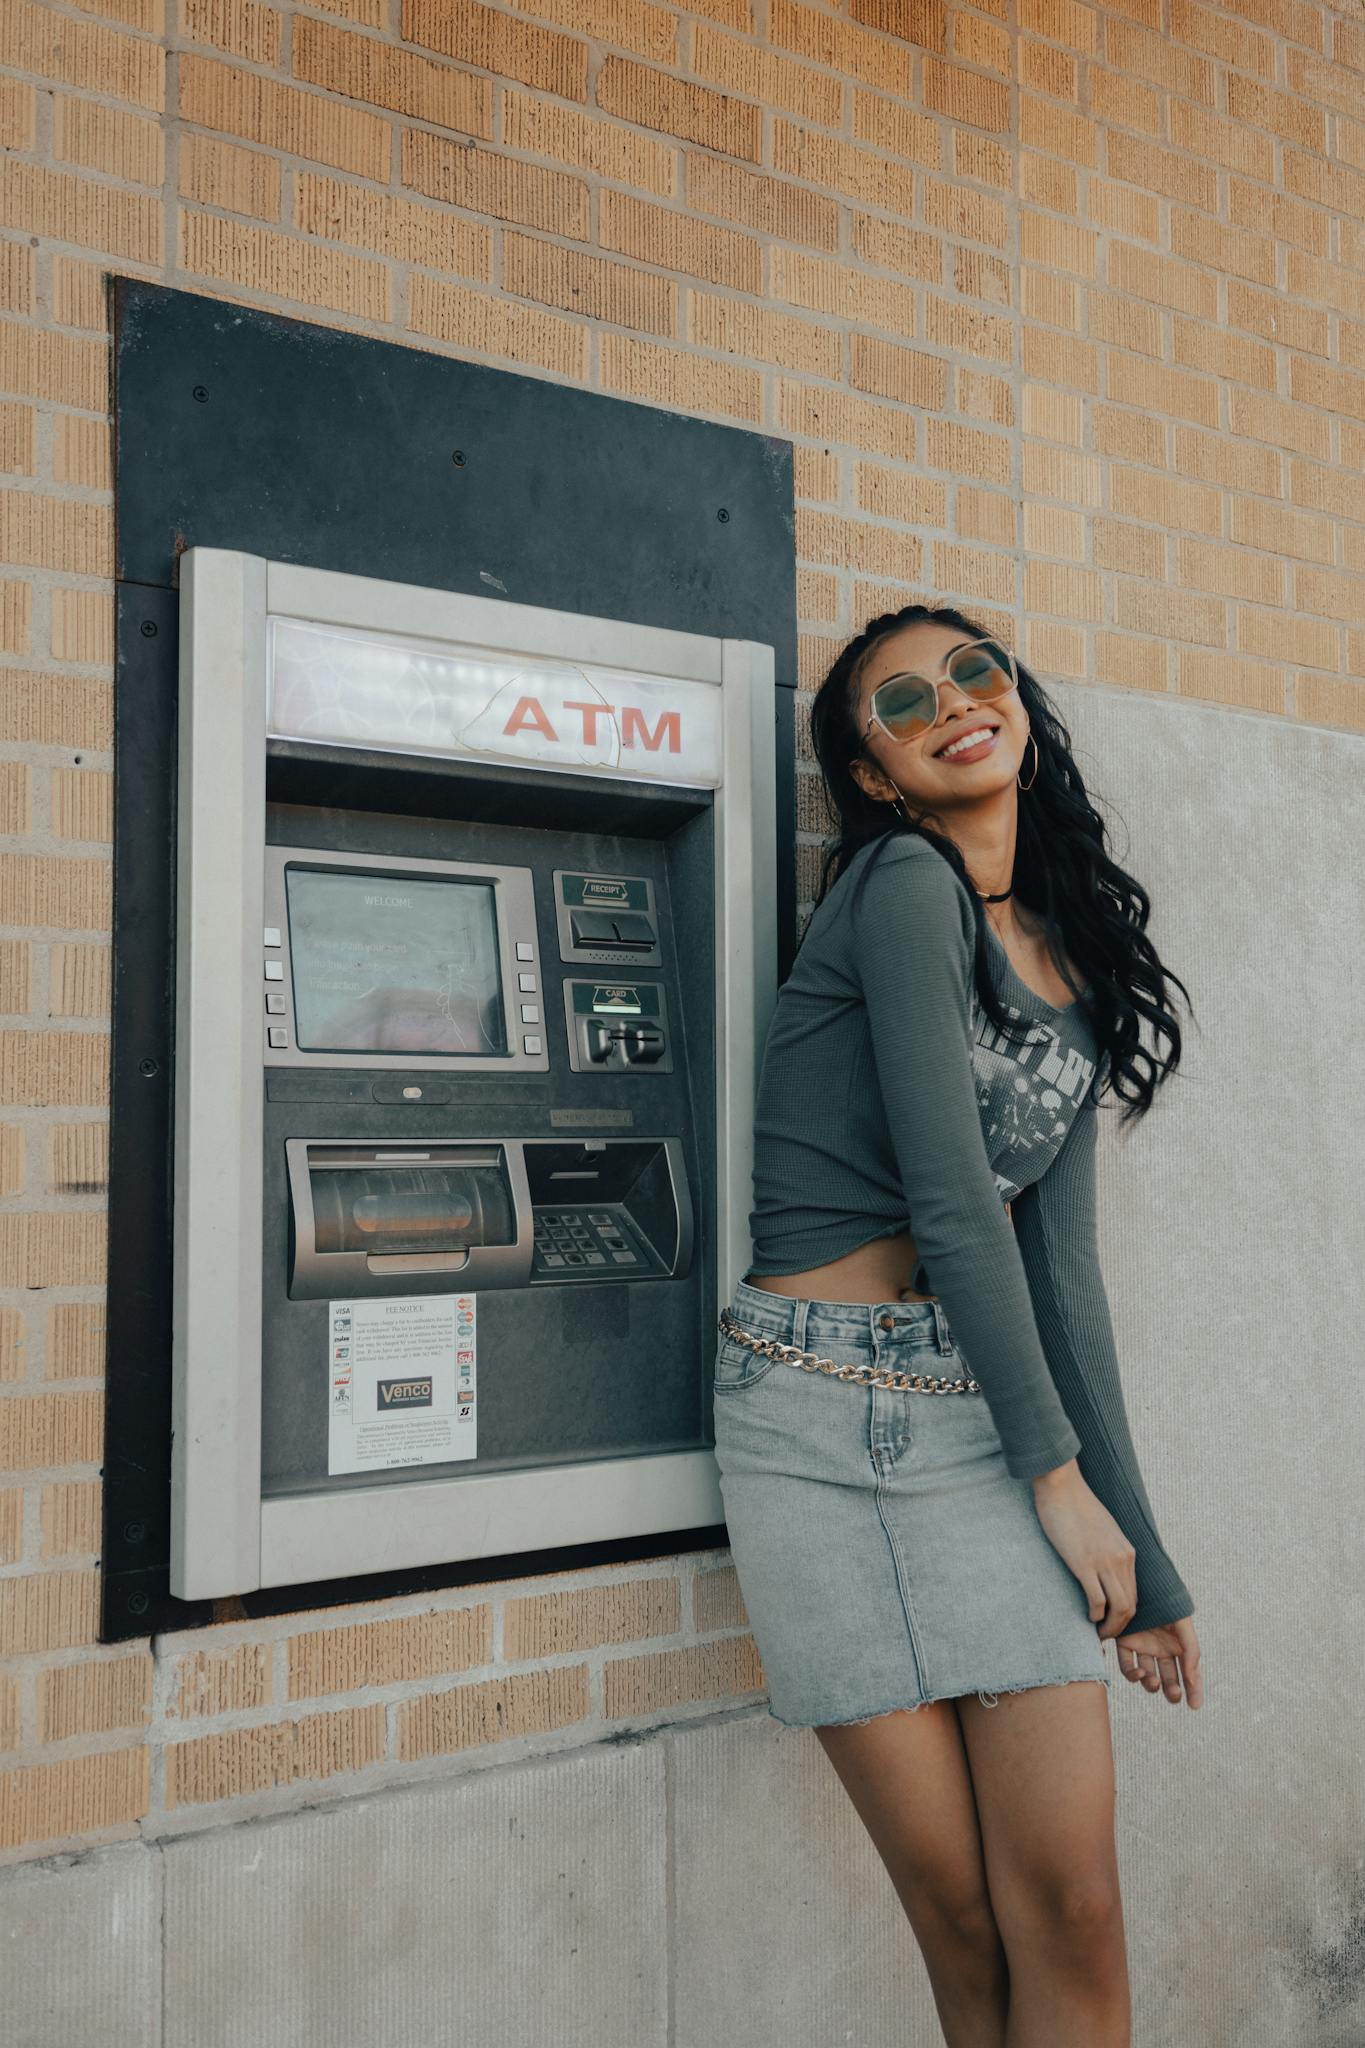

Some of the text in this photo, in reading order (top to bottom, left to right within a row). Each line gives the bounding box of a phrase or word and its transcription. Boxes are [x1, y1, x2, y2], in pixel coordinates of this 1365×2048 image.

[501, 695, 682, 754] ATM
[590, 884, 620, 895] RECEIPT
[363, 895, 414, 908] WELCOME
[605, 989, 627, 998] CARD
[335, 1307, 351, 1315] VISA
[398, 1304, 424, 1313] NOTICE
[381, 1381, 431, 1403] Venco
